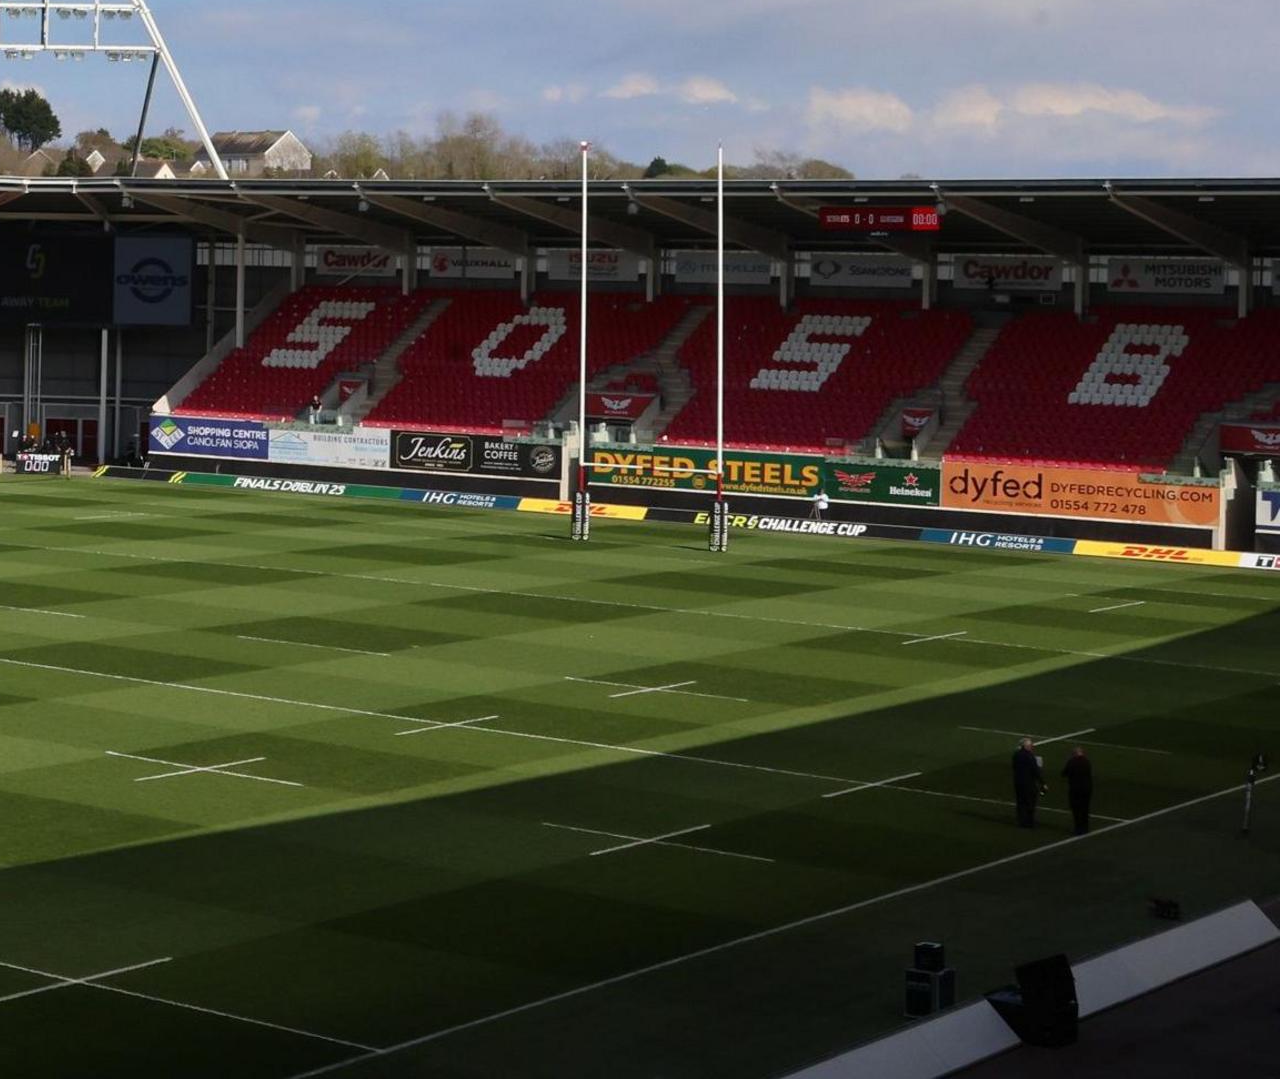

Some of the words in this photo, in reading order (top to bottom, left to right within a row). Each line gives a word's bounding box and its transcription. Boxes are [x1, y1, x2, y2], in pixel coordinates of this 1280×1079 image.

[323, 249, 389, 268] Cawdor
[963, 260, 1053, 281] Cawdor
[1145, 264, 1222, 276] MITSUBISHI
[115, 273, 188, 287] owens
[1155, 277, 1211, 288] MOTORS
[1, 296, 34, 308] AWAY
[187, 426, 231, 437] SHOPPING
[232, 429, 267, 440] CENTRE
[187, 436, 233, 448] CANOLFAN
[233, 440, 259, 450] SIOPA
[344, 436, 388, 446] CONTRACTORS
[484, 441, 513, 451] BAKERY
[400, 437, 467, 461] Jenkins
[484, 450, 519, 460] COFFEE
[593, 452, 695, 479] DYFED
[708, 457, 819, 487] STEELS
[234, 477, 280, 490] FINALS
[281, 481, 328, 494] DUBLIN
[329, 484, 346, 496] 23
[612, 475, 640, 486] 01554
[641, 476, 675, 487] 772255
[949, 468, 1043, 502] dyfed
[422, 491, 458, 505] IHG
[458, 493, 488, 503] HOTELS
[889, 486, 931, 497] Heineken
[1051, 482, 1213, 504] DYFEDRECYCLING.COM
[456, 500, 494, 508] RESORTS
[554, 503, 607, 515] DL
[1050, 499, 1089, 512] 01554
[1094, 503, 1117, 514] 772
[1122, 504, 1146, 516] 478
[694, 512, 747, 527] ECR
[757, 517, 837, 535] CHALLENGE
[837, 524, 867, 536] CUP
[949, 532, 993, 547] IHG
[994, 541, 1042, 551] RESORTS
[996, 535, 1034, 544] HOTELS
[1120, 546, 1190, 561] DHL
